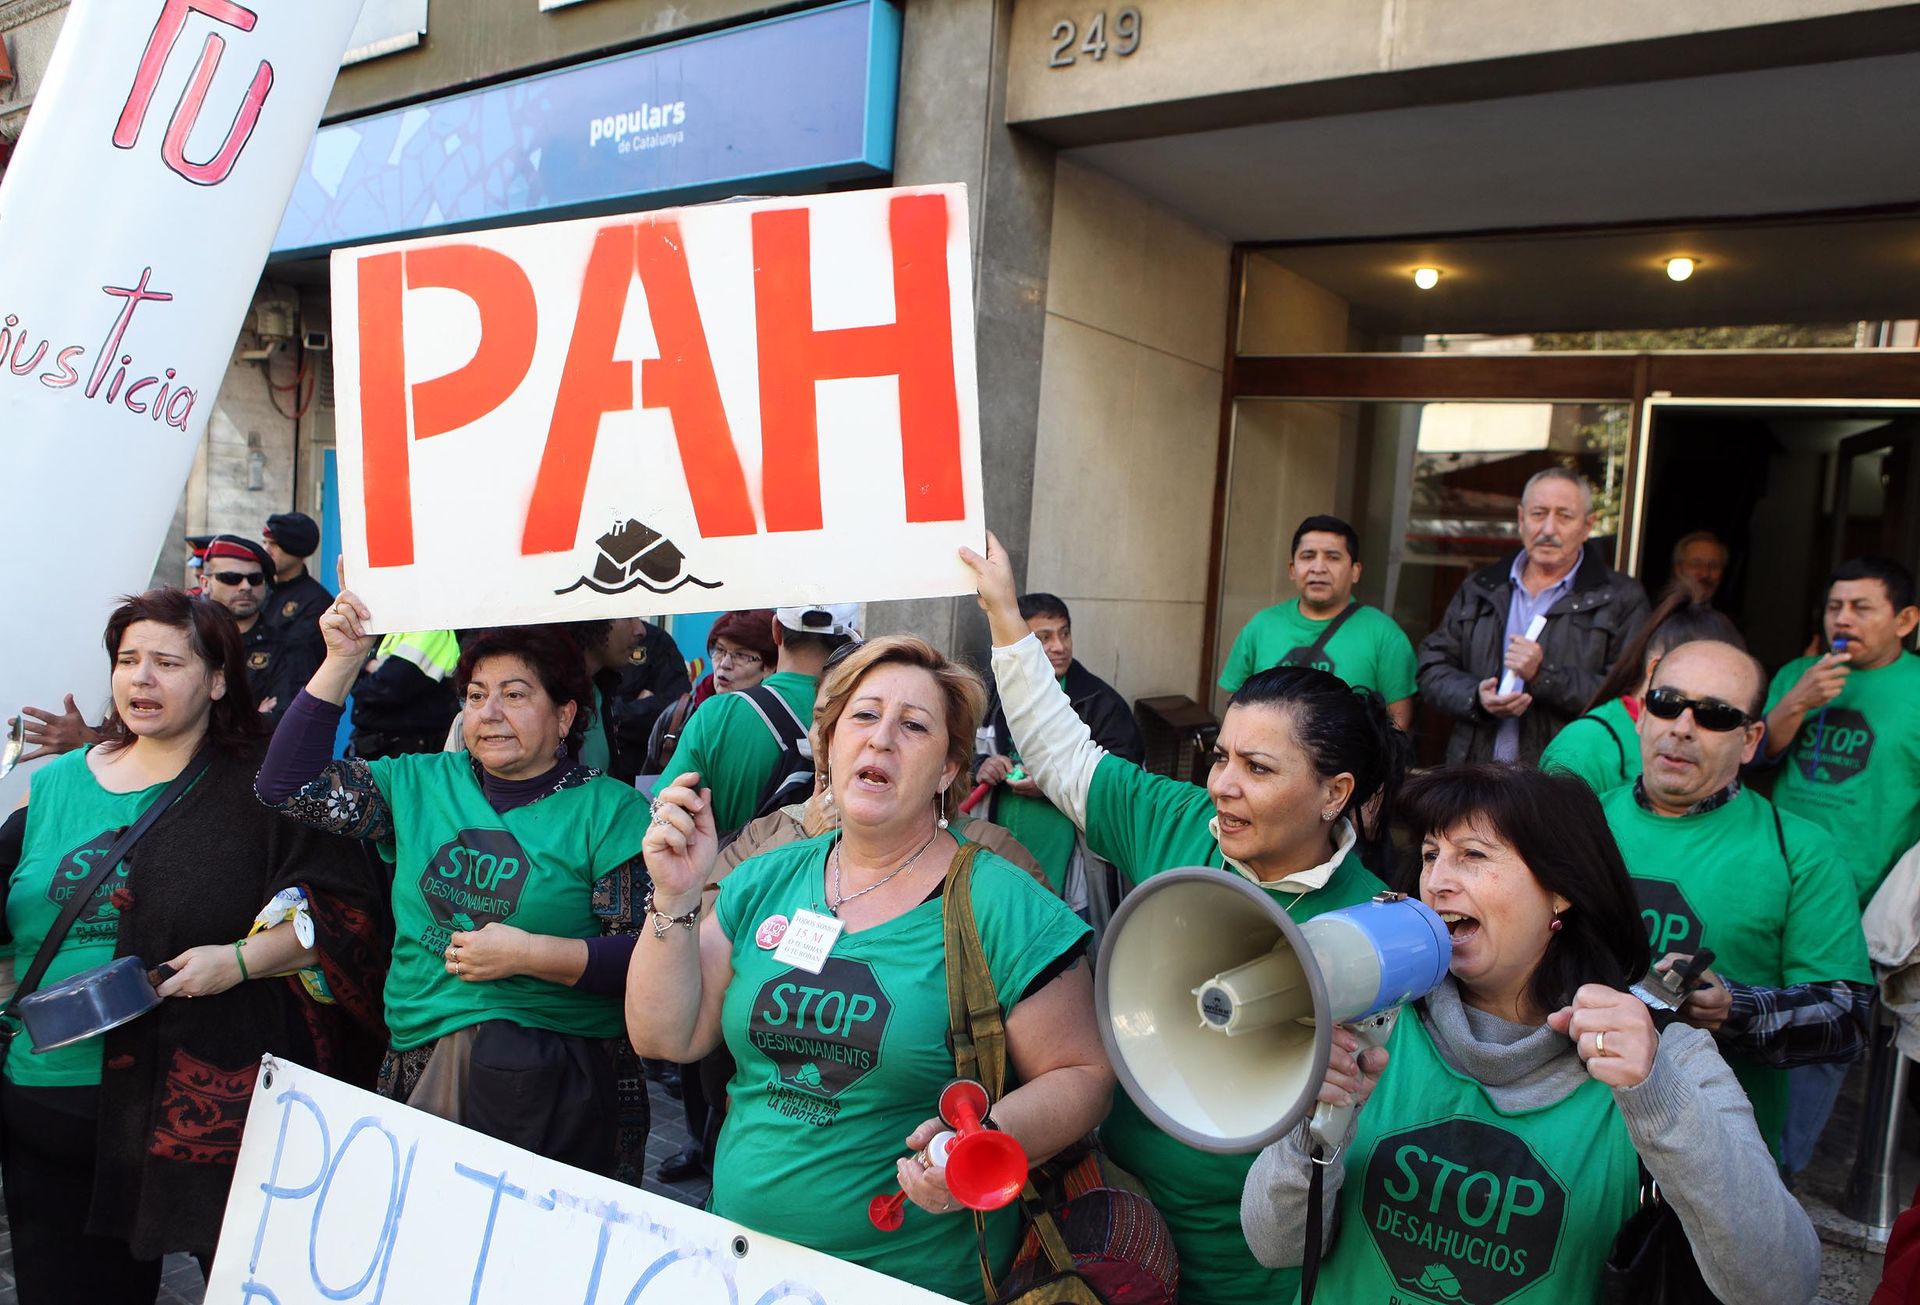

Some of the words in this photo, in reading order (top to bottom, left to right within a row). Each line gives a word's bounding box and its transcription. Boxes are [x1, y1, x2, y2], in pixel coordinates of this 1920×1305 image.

[1049, 8, 1142, 68] 249
[589, 101, 687, 147] populars
[618, 140, 631, 154] de
[632, 131, 684, 151] Catalunya
[357, 194, 965, 568] PAH
[1801, 722, 1869, 755] STOP
[439, 846, 519, 891] STOP
[424, 877, 511, 916] DESNONAMENTS
[424, 925, 452, 941] PLAT
[763, 921, 787, 935] STOP
[1641, 909, 1690, 953] OP
[763, 983, 877, 1038] STOP
[756, 1031, 871, 1070] DESNONAMENTS
[767, 1096, 777, 1111] LA
[779, 1101, 834, 1128] HIPOTECA
[820, 1105, 840, 1118] PER
[1383, 1144, 1545, 1235] STOP
[1376, 1203, 1528, 1277] DESAHUCIOS
